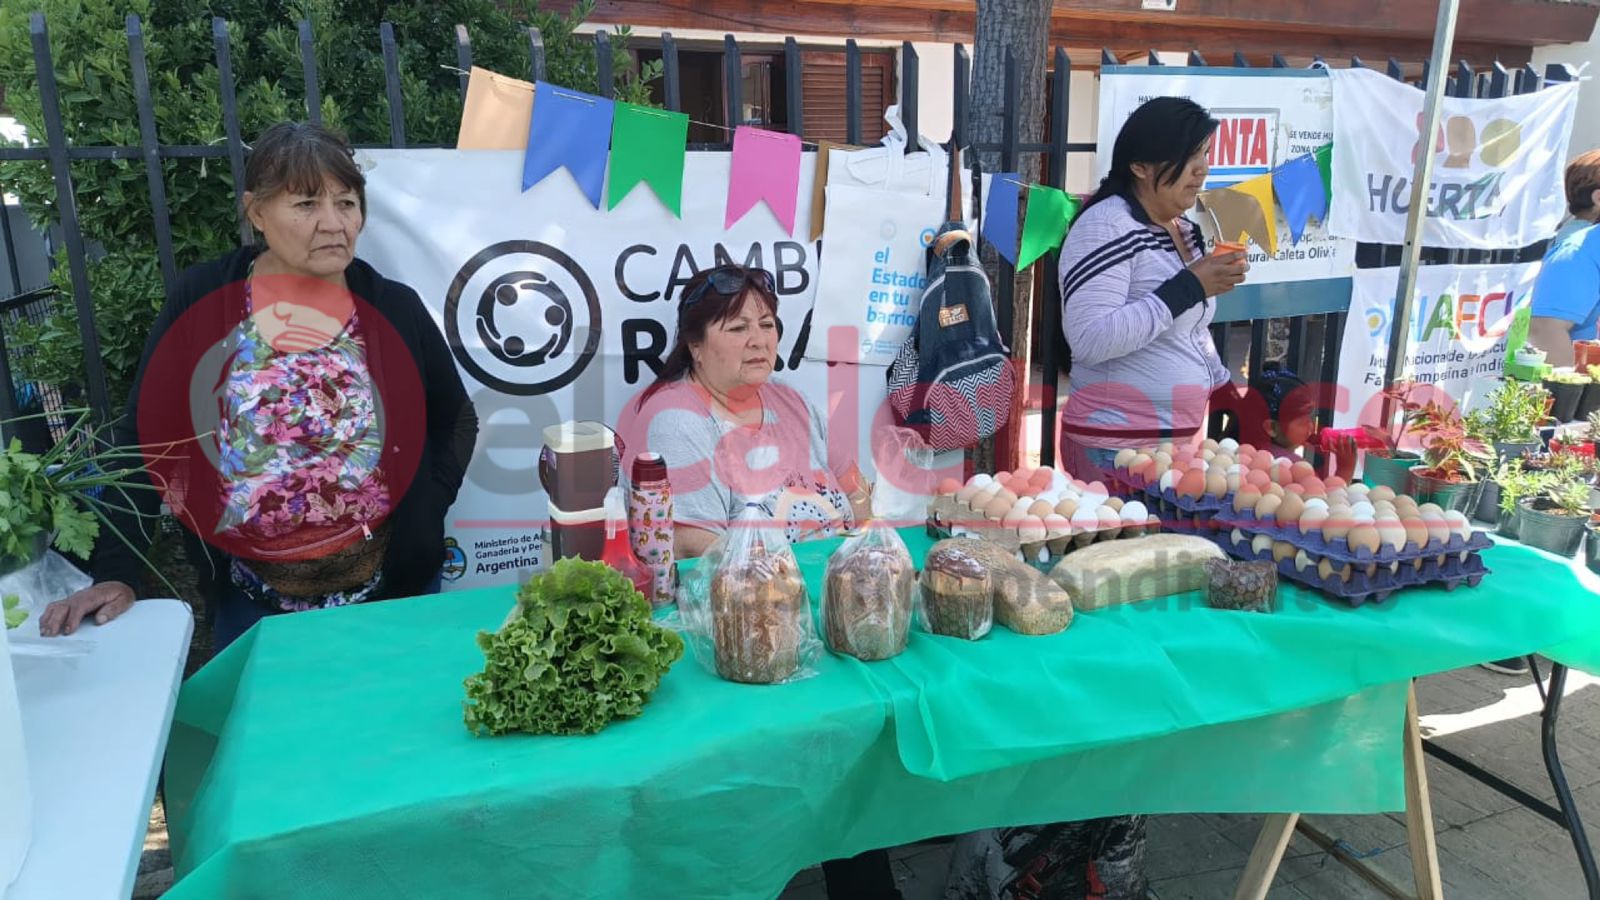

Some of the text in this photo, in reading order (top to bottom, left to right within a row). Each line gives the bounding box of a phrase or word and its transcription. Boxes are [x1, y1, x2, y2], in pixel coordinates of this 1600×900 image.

[1206, 118, 1268, 166] INTA
[874, 246, 890, 264] el
[872, 268, 928, 290] Estado
[869, 289, 909, 306] en tu
[866, 305, 915, 327] barrio
[474, 536, 519, 550] Ministerio
[520, 533, 533, 543] de
[521, 545, 528, 555] y
[475, 555, 539, 575] Argentina
